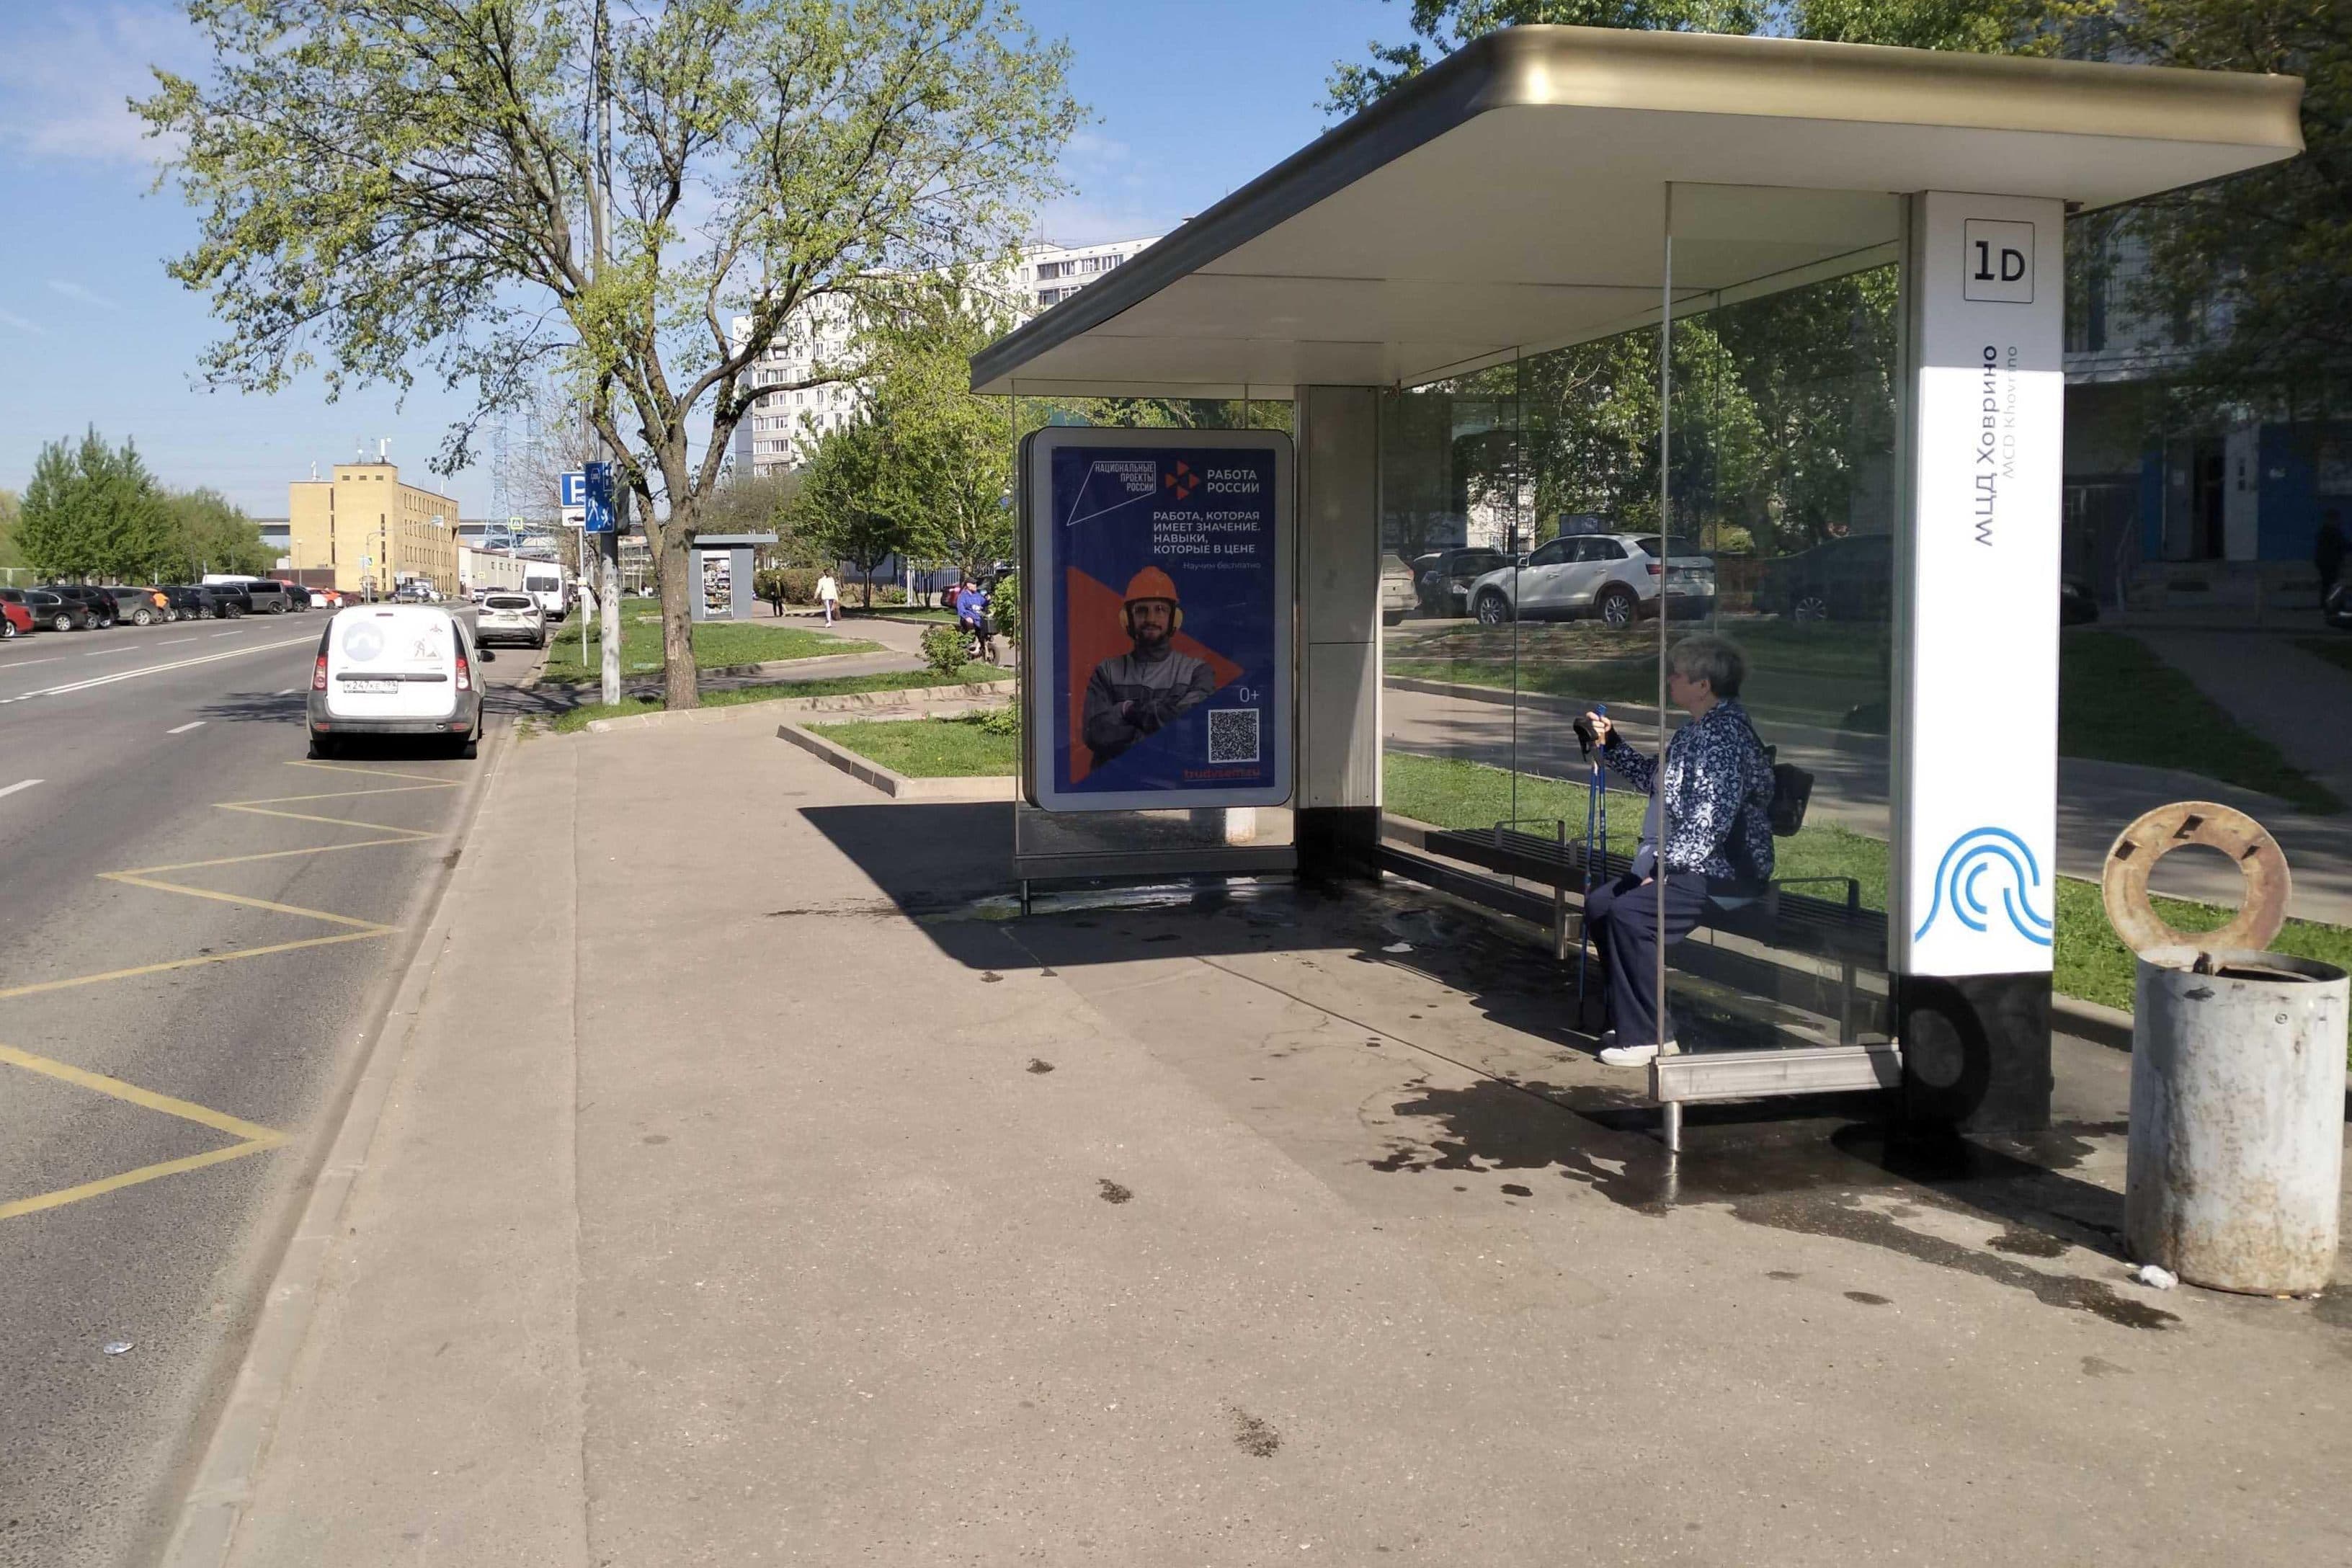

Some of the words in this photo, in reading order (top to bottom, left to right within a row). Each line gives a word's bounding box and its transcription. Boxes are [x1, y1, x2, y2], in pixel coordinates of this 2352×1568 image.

[1974, 240, 2026, 281] 1D
[2003, 346, 2018, 428] Khovrno
[1977, 345, 2000, 464] Ховрино
[2003, 435, 2015, 478] MCD
[1095, 463, 1154, 473] НАЦИОНАЛЬНЫЕ
[1121, 473, 1154, 482] ПРОЕКТЫ
[1207, 469, 1257, 481] РАБОТА
[1126, 483, 1154, 491] РОССИИ
[1207, 482, 1260, 493] РОССИИ
[1974, 473, 1997, 546] МЦД
[1153, 512, 1203, 522] РАБОТА,
[1206, 512, 1260, 520] КОТОРАЯ
[1153, 523, 1193, 532] ИМЕЕТ
[1196, 522, 1260, 532] ЗНАЧЕНИЕ.
[1153, 534, 1208, 544] НАВЫКИ,
[1153, 545, 1211, 554] КОТОРЫЕ
[1213, 545, 1221, 553] В
[1225, 544, 1255, 555] ЦЕНЕ
[1240, 687, 1260, 703] 0+
